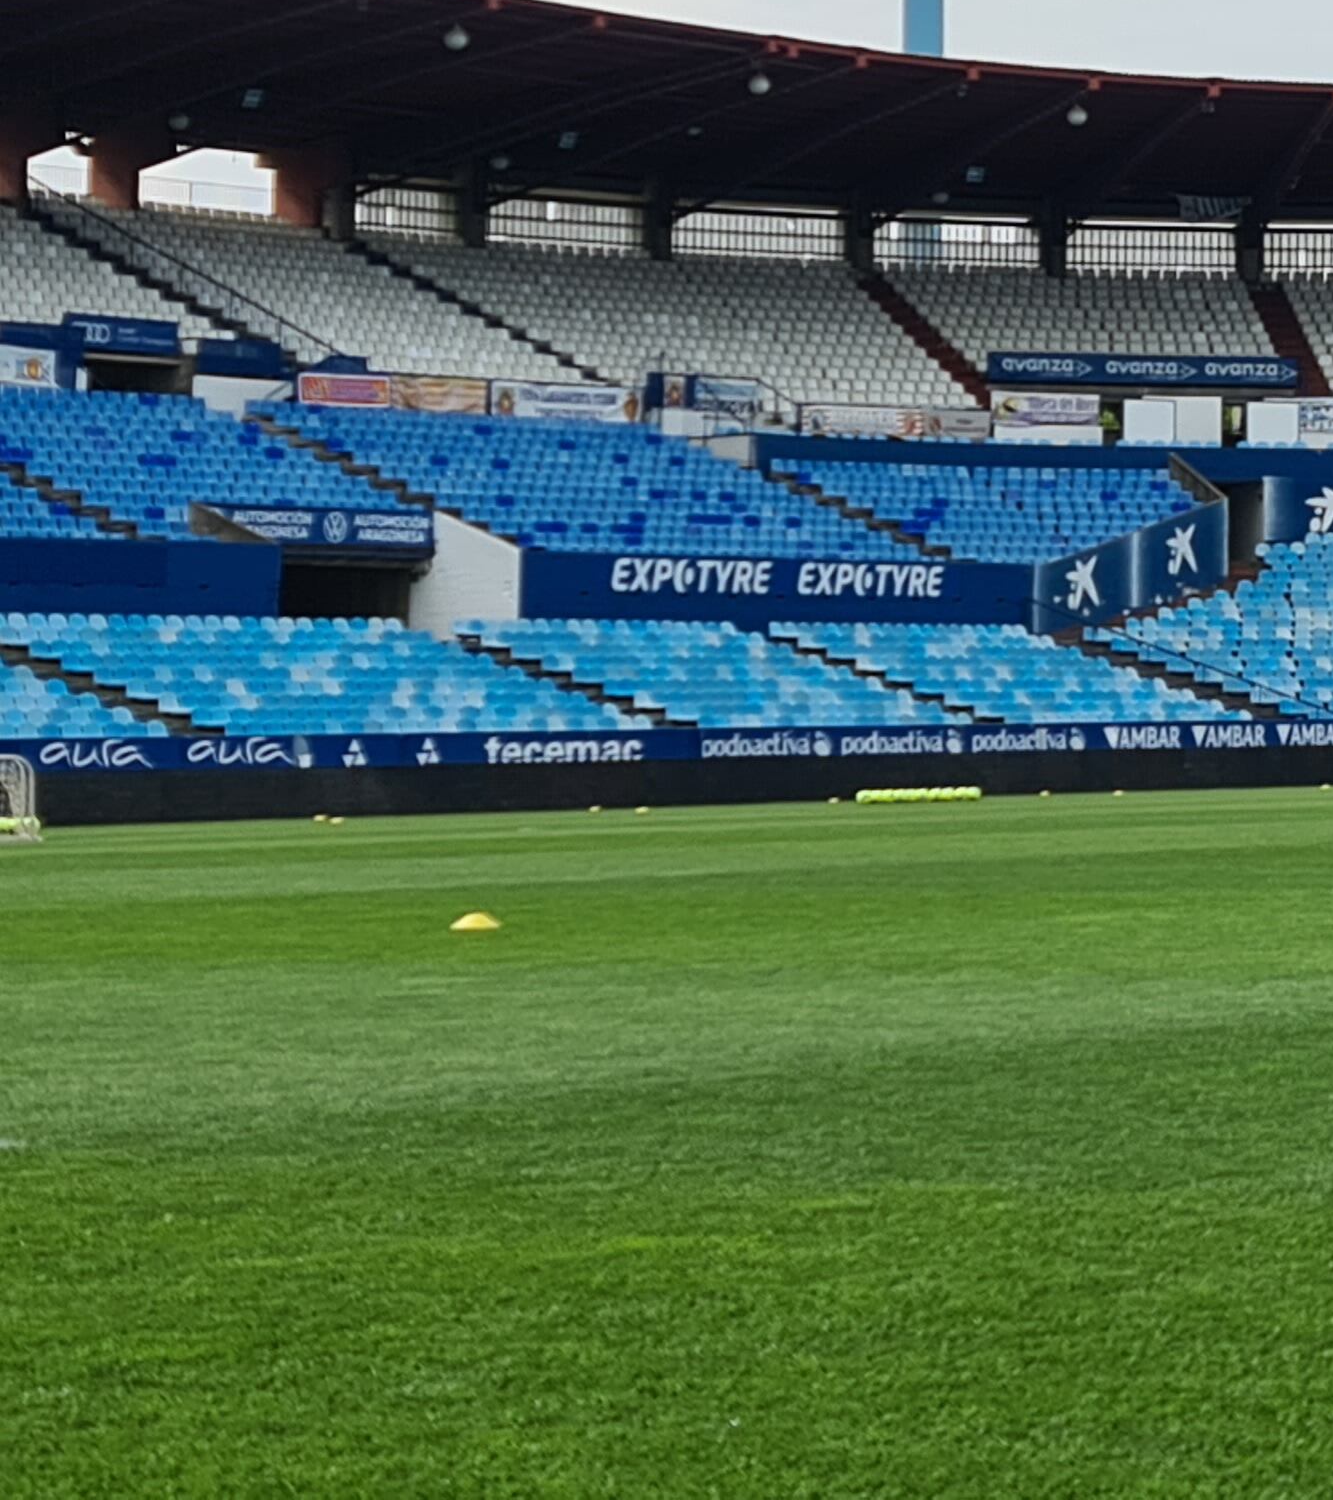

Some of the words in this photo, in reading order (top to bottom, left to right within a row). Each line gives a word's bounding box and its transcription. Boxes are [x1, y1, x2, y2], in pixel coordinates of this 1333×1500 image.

[1002, 357, 1074, 372] avanza
[1105, 359, 1178, 375] avanza
[1204, 361, 1279, 376] avanza
[610, 557, 774, 594] EXPOTYRE
[797, 562, 945, 598] EXPOTYRE
[702, 731, 810, 757] podoactiva
[840, 730, 944, 756] podoactiva
[972, 729, 1067, 753] podoactiva
[1120, 726, 1182, 749] AMBAR
[1205, 725, 1266, 748] AMBAR
[39, 739, 155, 768] aura
[187, 736, 296, 765] aura
[484, 736, 644, 765] tecemac
